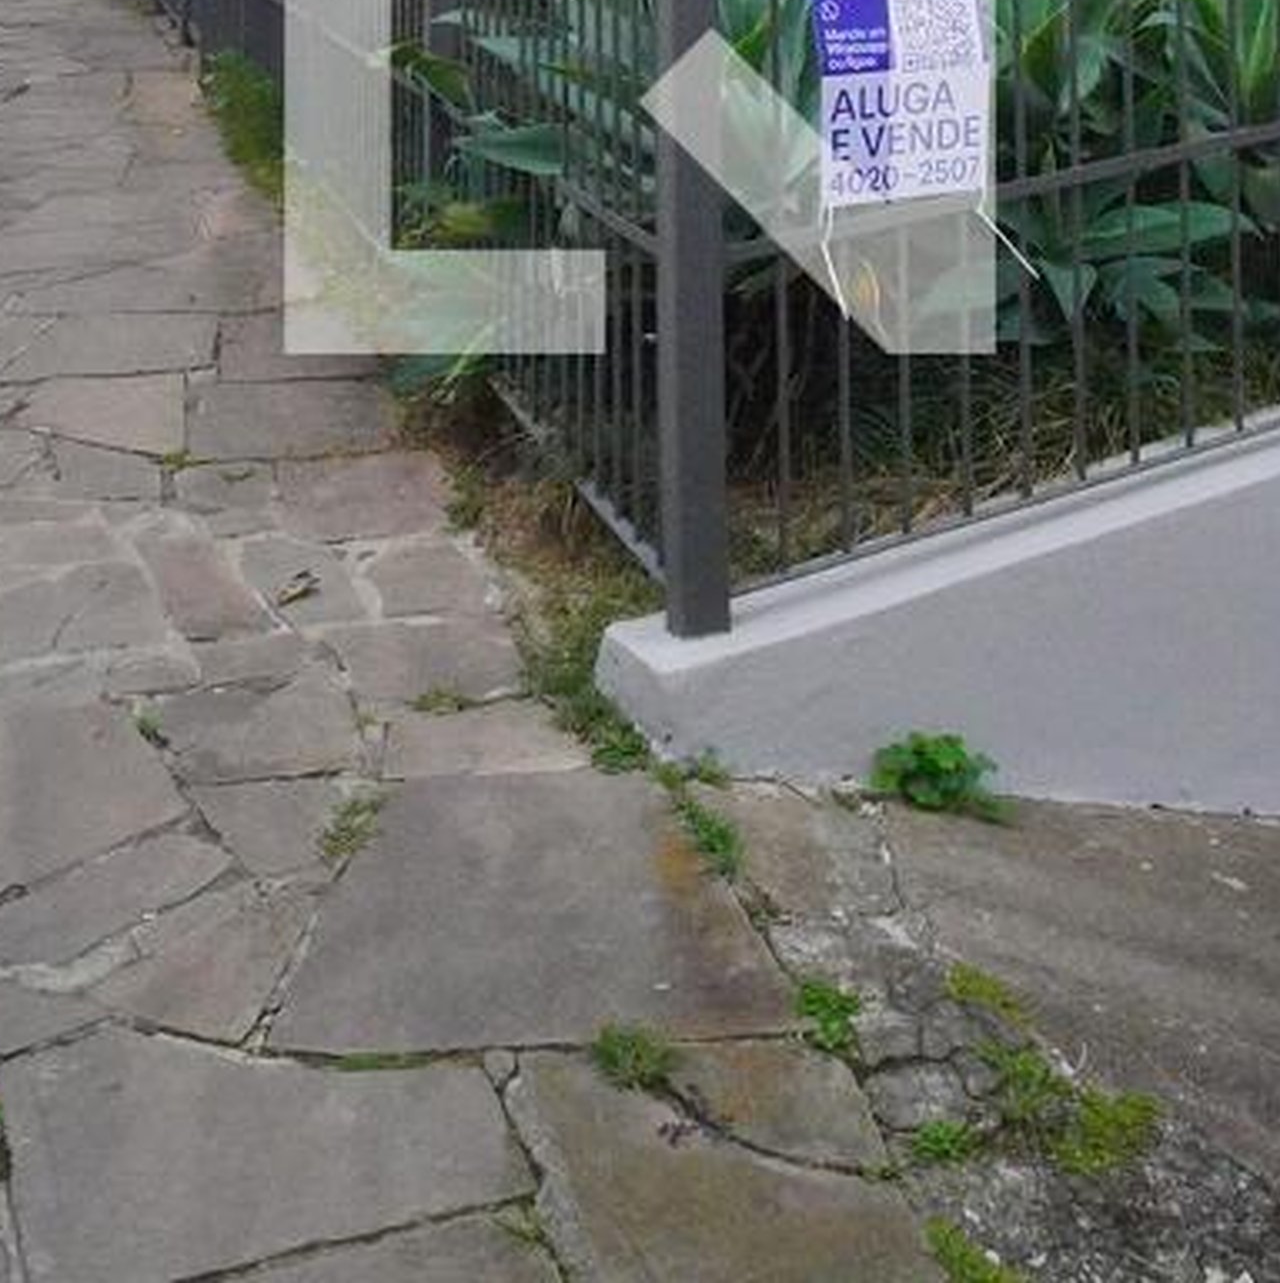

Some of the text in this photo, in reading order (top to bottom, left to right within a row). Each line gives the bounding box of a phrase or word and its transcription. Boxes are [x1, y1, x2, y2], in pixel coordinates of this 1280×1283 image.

[830, 80, 957, 123] ALUGA
[831, 115, 982, 162] E VENDE
[830, 157, 981, 196] 4020-2507
